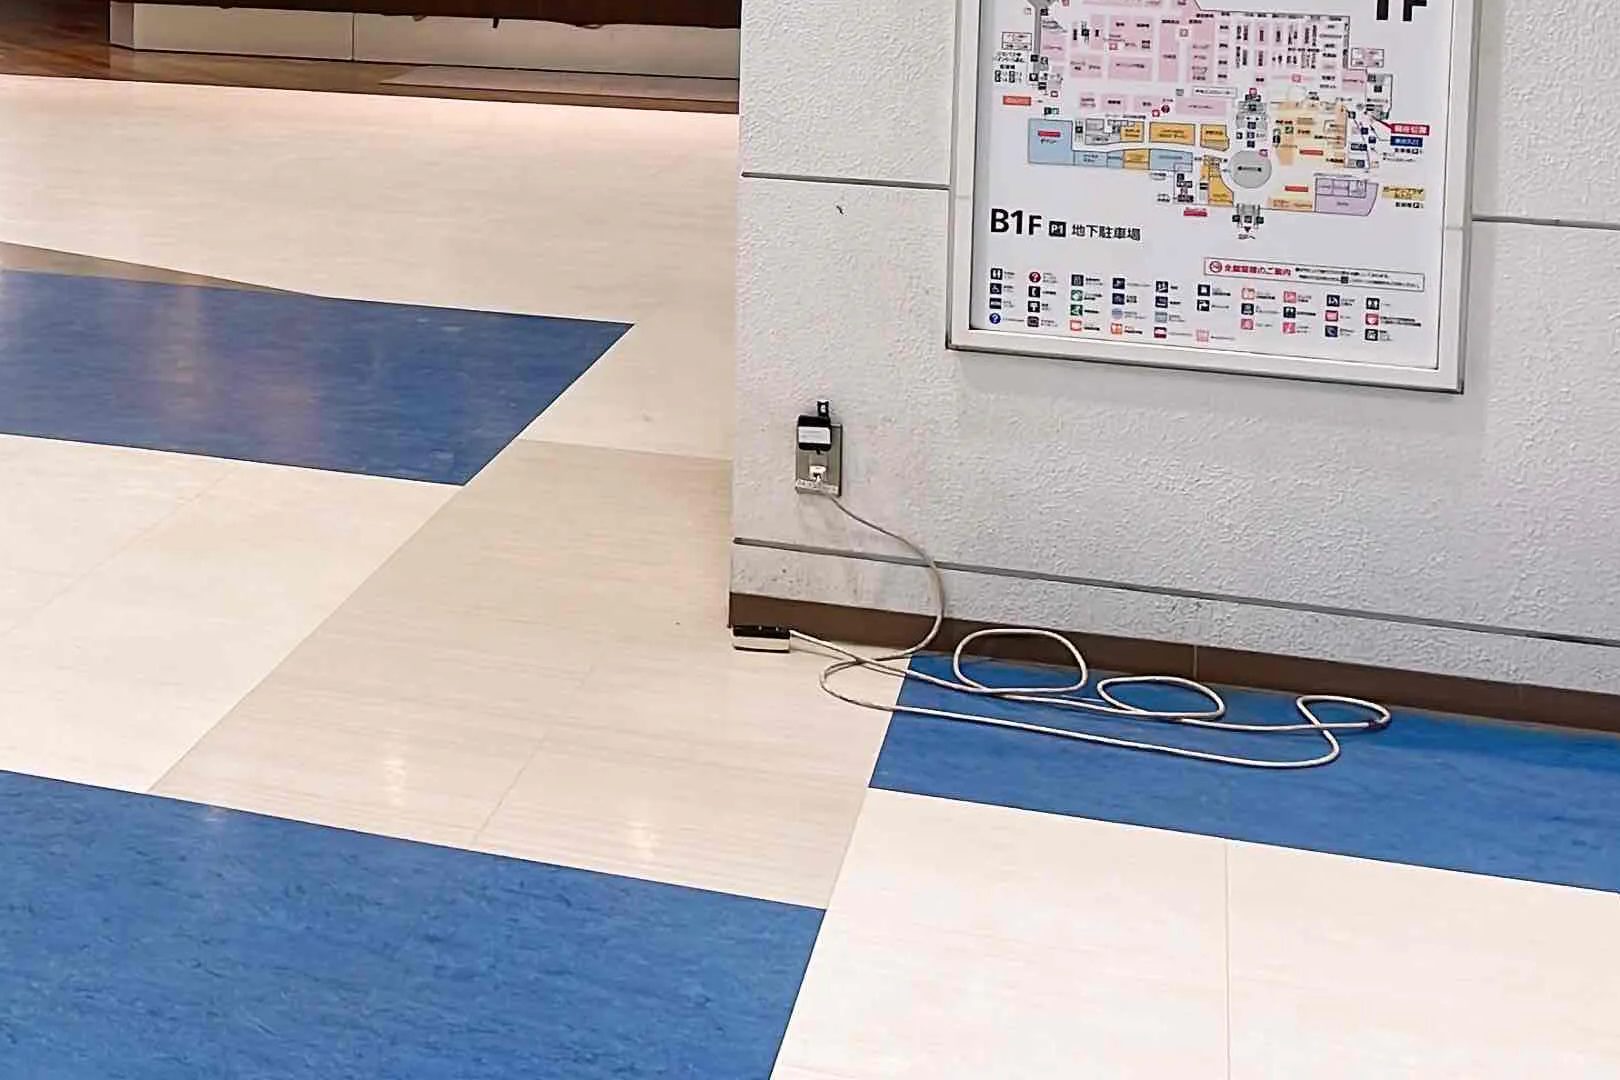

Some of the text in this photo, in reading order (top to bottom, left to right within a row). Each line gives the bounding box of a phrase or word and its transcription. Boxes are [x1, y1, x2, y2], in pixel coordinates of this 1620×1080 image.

[991, 208, 1042, 235] B1F
[1072, 223, 1141, 241] 地下駐車場
